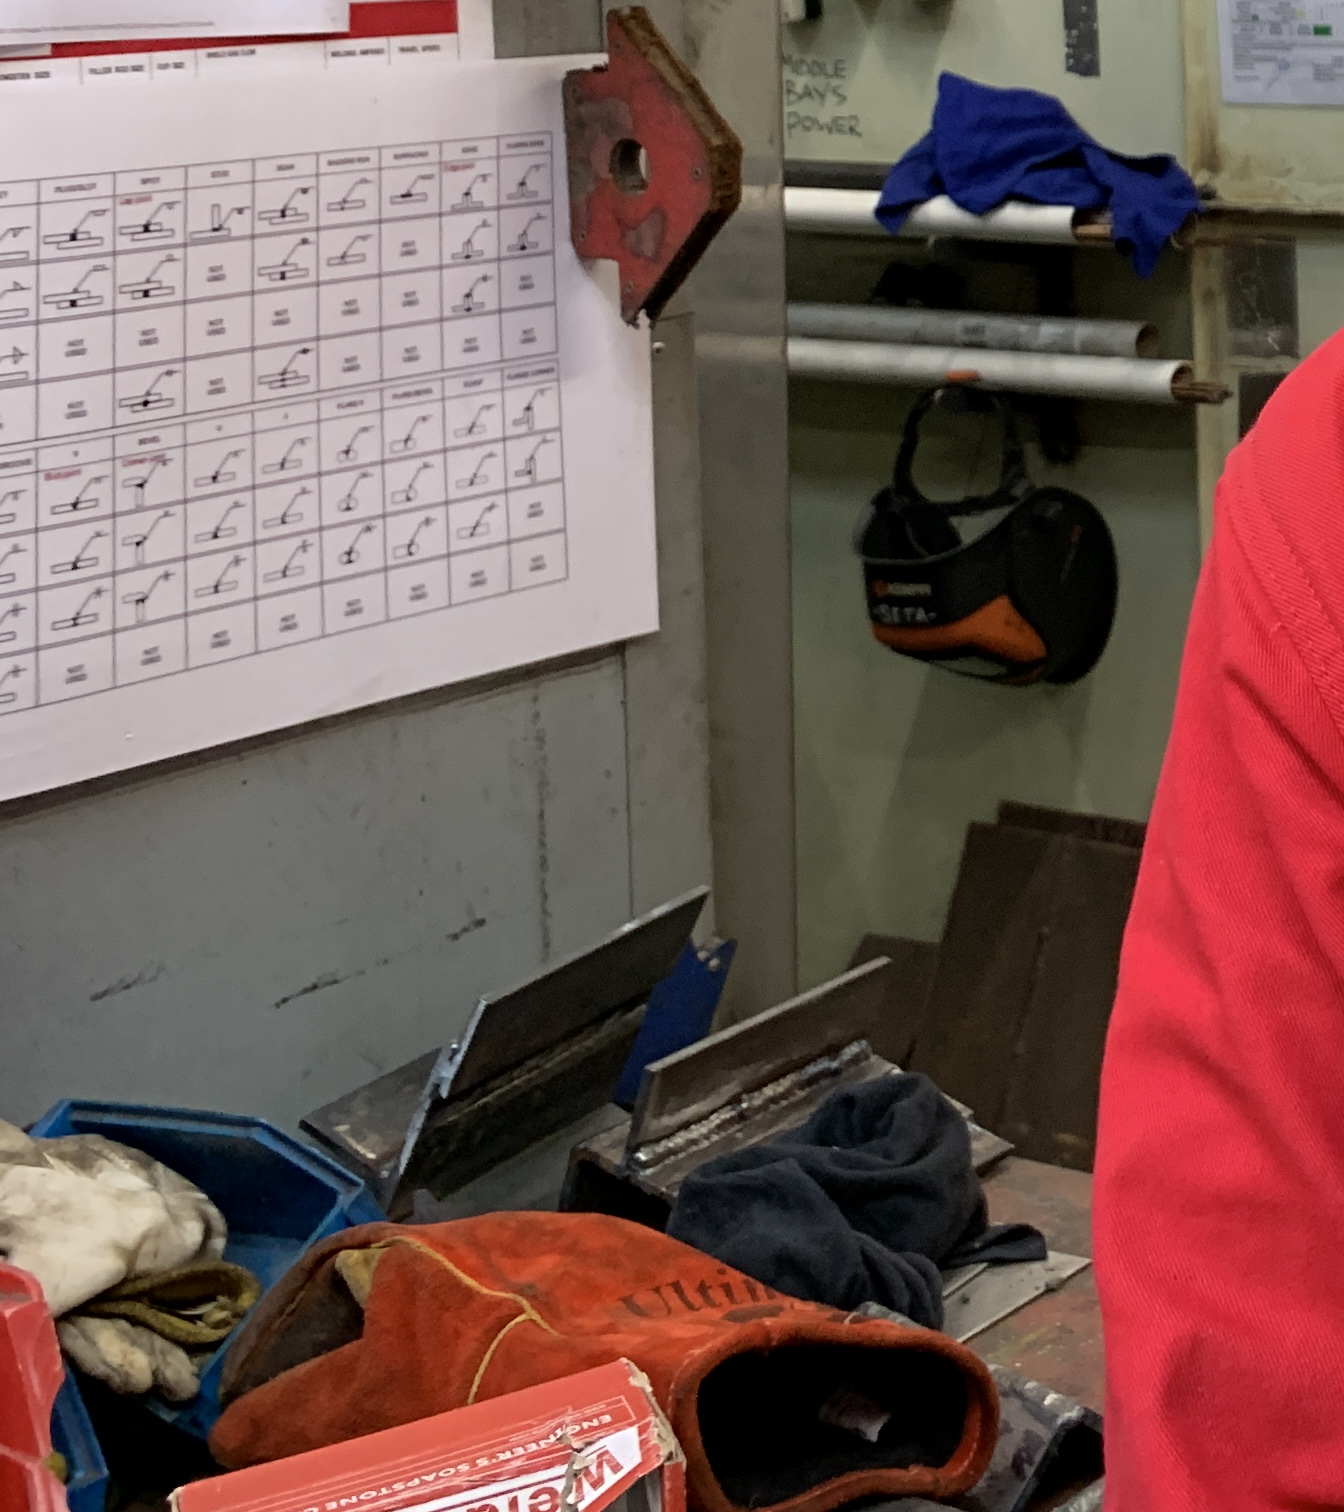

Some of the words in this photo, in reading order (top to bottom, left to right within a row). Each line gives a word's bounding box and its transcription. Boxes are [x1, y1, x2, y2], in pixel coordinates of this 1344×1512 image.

[787, 110, 863, 139] POWER
[474, 1413, 613, 1470] ENGINEER'S
[324, 1462, 471, 1511] SOAPSTONE
